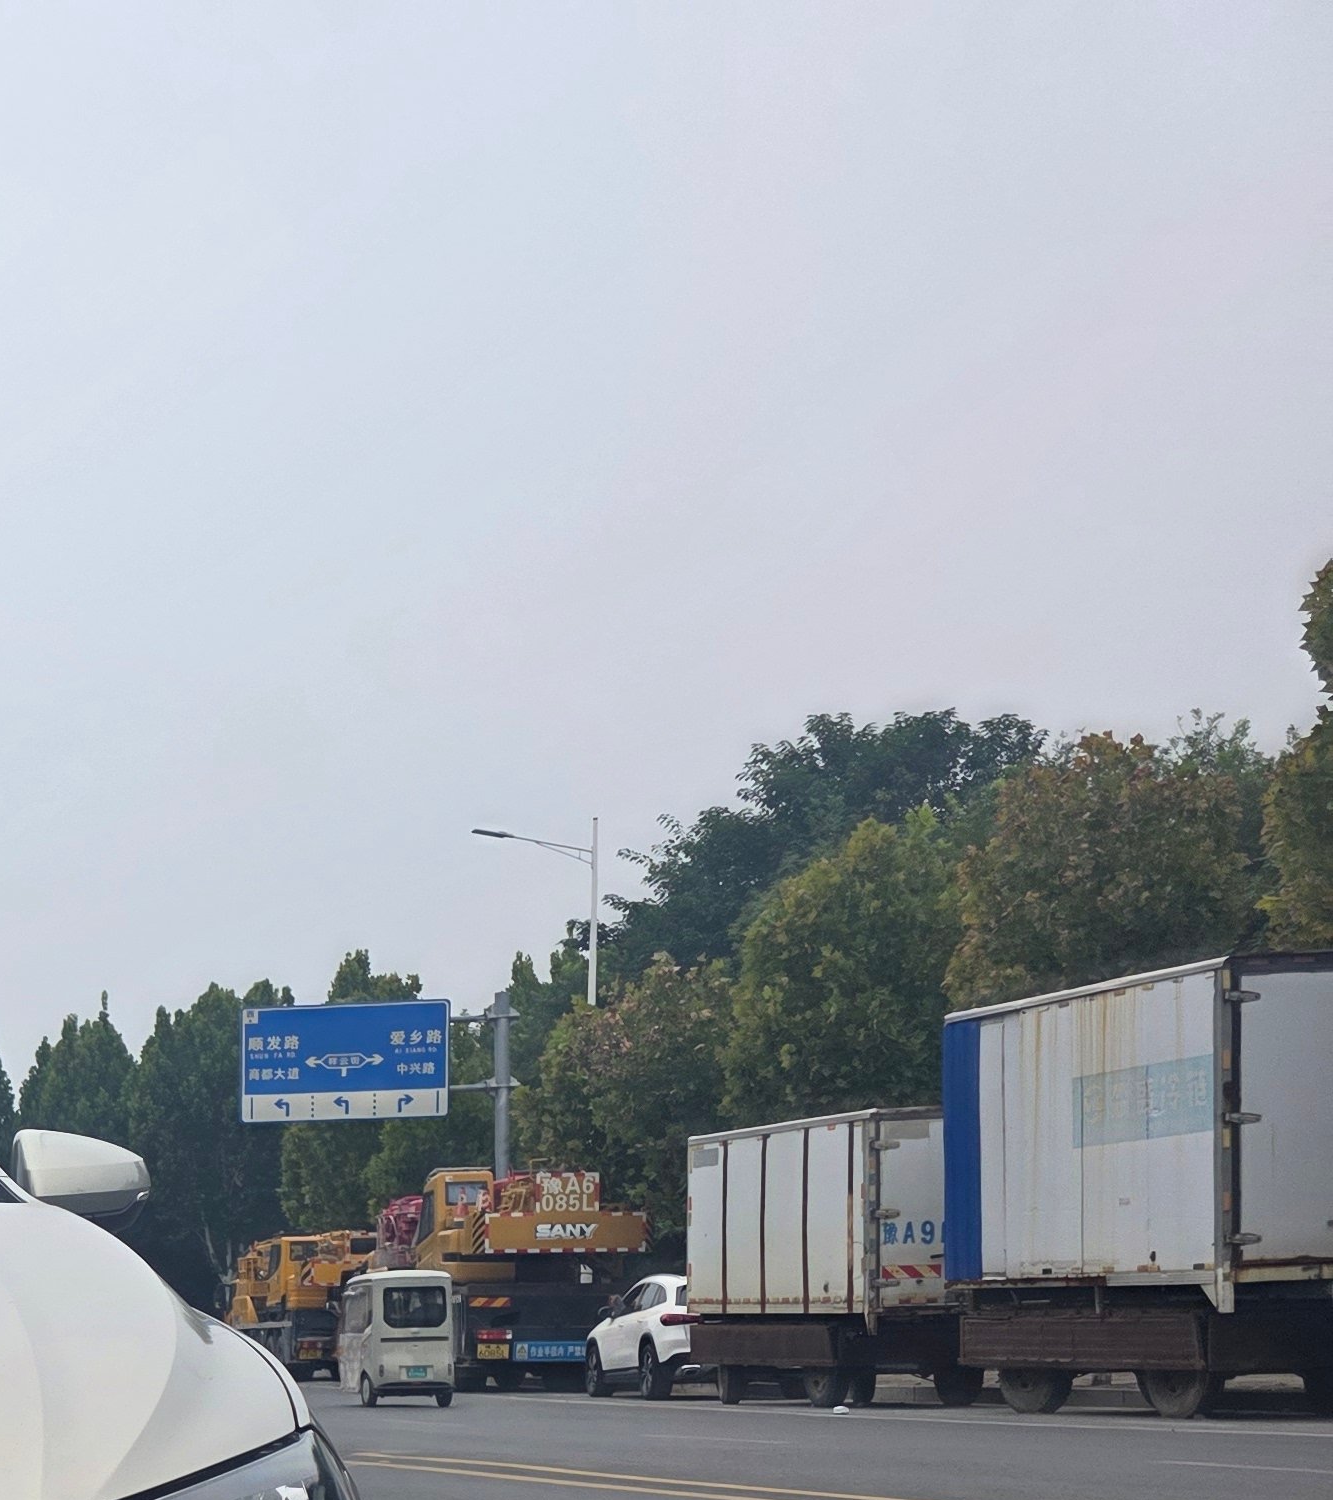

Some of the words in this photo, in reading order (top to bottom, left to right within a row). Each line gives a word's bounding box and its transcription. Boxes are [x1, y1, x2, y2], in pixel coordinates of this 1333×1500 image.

[248, 1034, 300, 1051] 顺发路
[389, 1029, 443, 1046] 爱乡路
[248, 1067, 300, 1081] 商都大道
[396, 1061, 436, 1076] 中兴路
[540, 1176, 595, 1195] 豫A6
[541, 1194, 595, 1212] 085L
[536, 1223, 598, 1240] SANY
[881, 1220, 945, 1245] 豫A9
